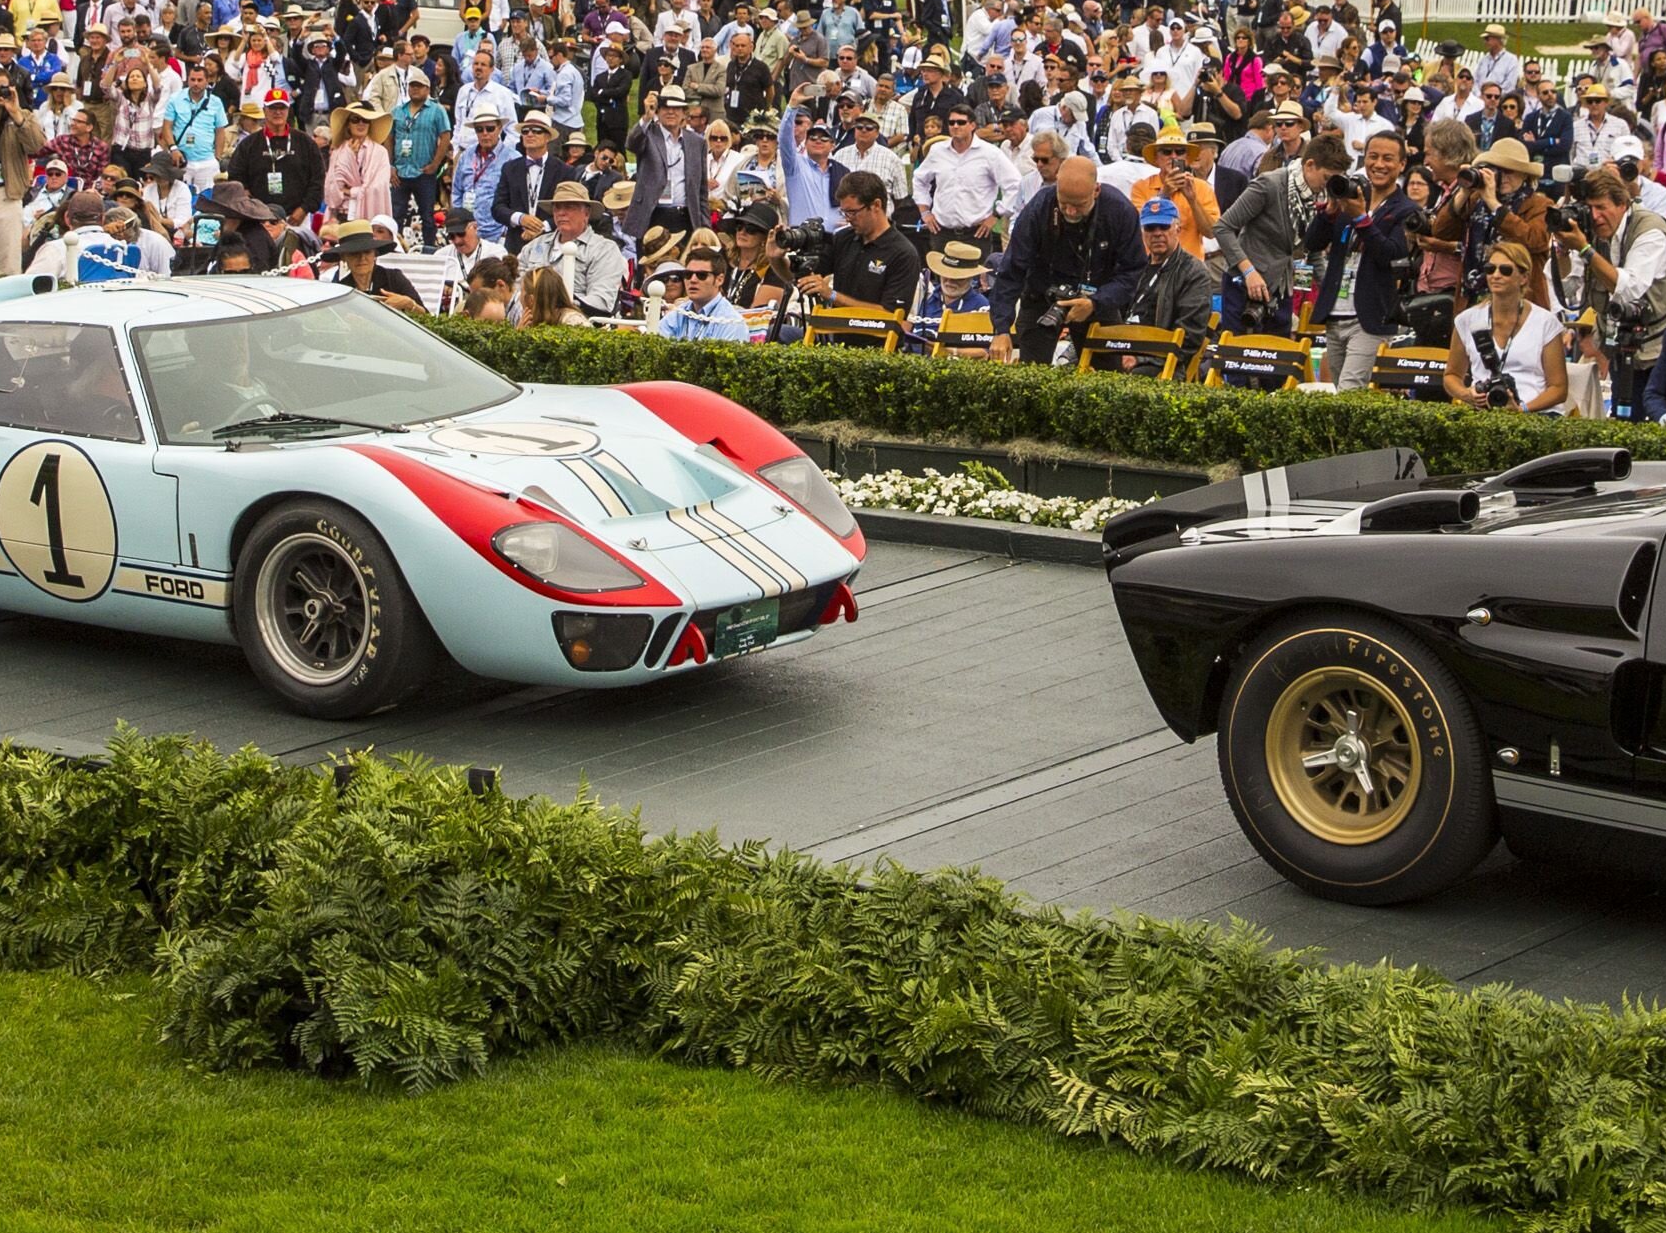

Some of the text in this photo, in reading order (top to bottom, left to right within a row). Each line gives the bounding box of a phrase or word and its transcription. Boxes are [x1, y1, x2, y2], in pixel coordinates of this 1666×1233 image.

[1105, 340, 1131, 349] Reuters
[1397, 358, 1426, 369] Kimmy
[456, 427, 582, 452] 1
[29, 453, 85, 589] 1
[144, 574, 205, 600] FORD
[1347, 637, 1444, 757] Firestone
